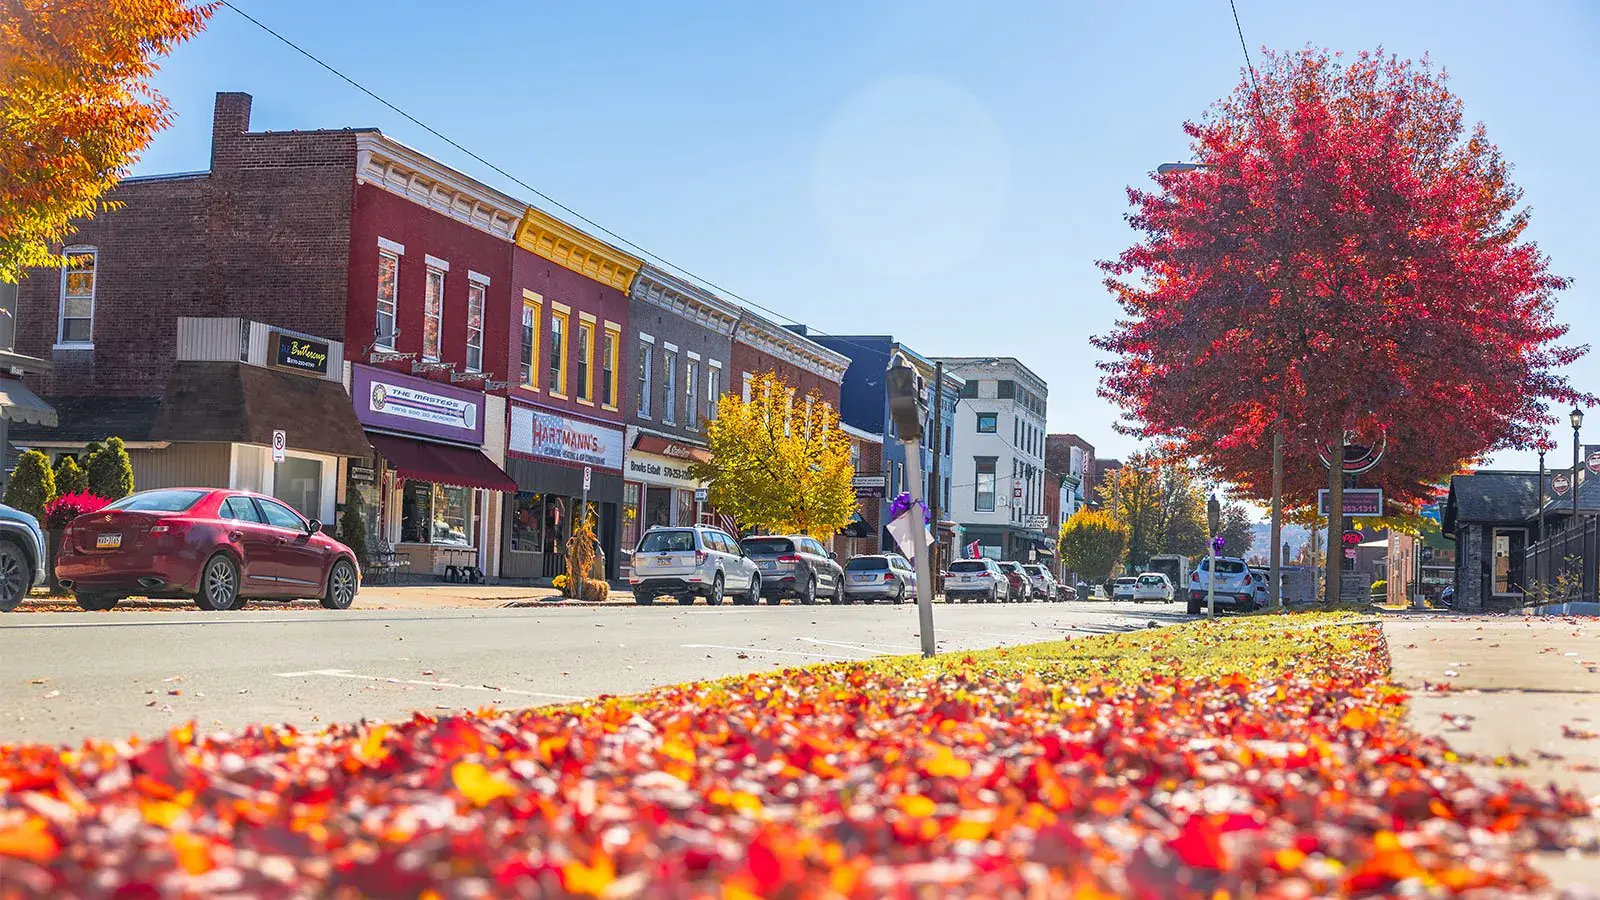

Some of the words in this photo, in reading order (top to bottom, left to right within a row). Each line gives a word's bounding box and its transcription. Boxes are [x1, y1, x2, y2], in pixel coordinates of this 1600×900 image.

[291, 341, 326, 366] Buttercup
[391, 388, 411, 398] THE
[414, 393, 459, 408] MASTERS
[391, 405, 407, 414] TANG
[432, 414, 457, 423] ACADEMY
[532, 412, 598, 452] HARTMANN'S
[631, 460, 647, 473] Brooks
[1341, 533, 1362, 545] PEN
